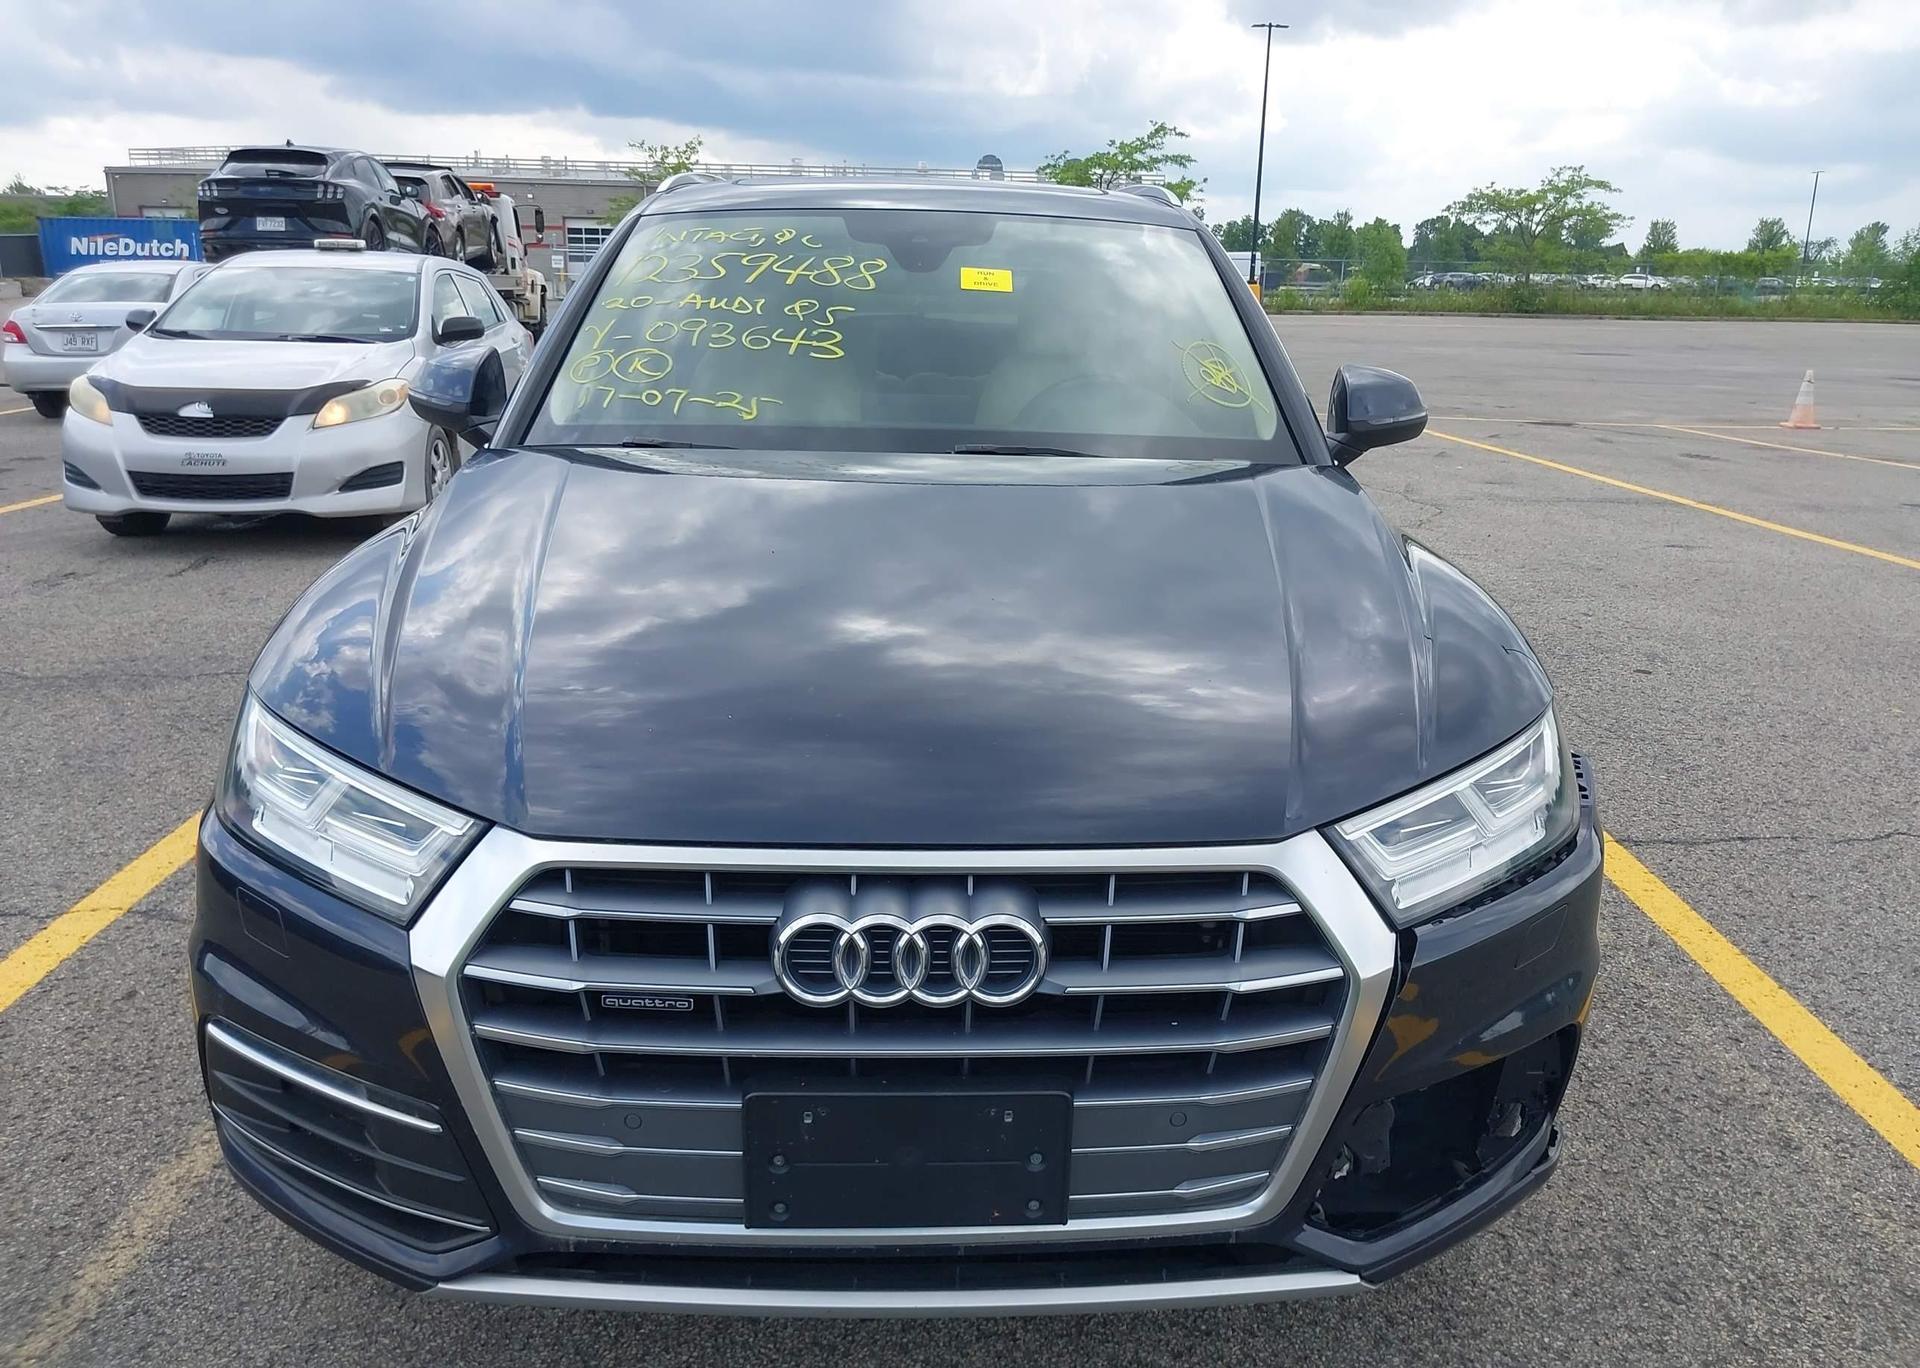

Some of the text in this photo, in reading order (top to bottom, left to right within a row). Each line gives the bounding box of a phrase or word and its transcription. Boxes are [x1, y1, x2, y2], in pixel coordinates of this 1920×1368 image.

[71, 236, 190, 256] NileDutch
[783, 300, 856, 326] Q5
[605, 998, 689, 1008] quattro
